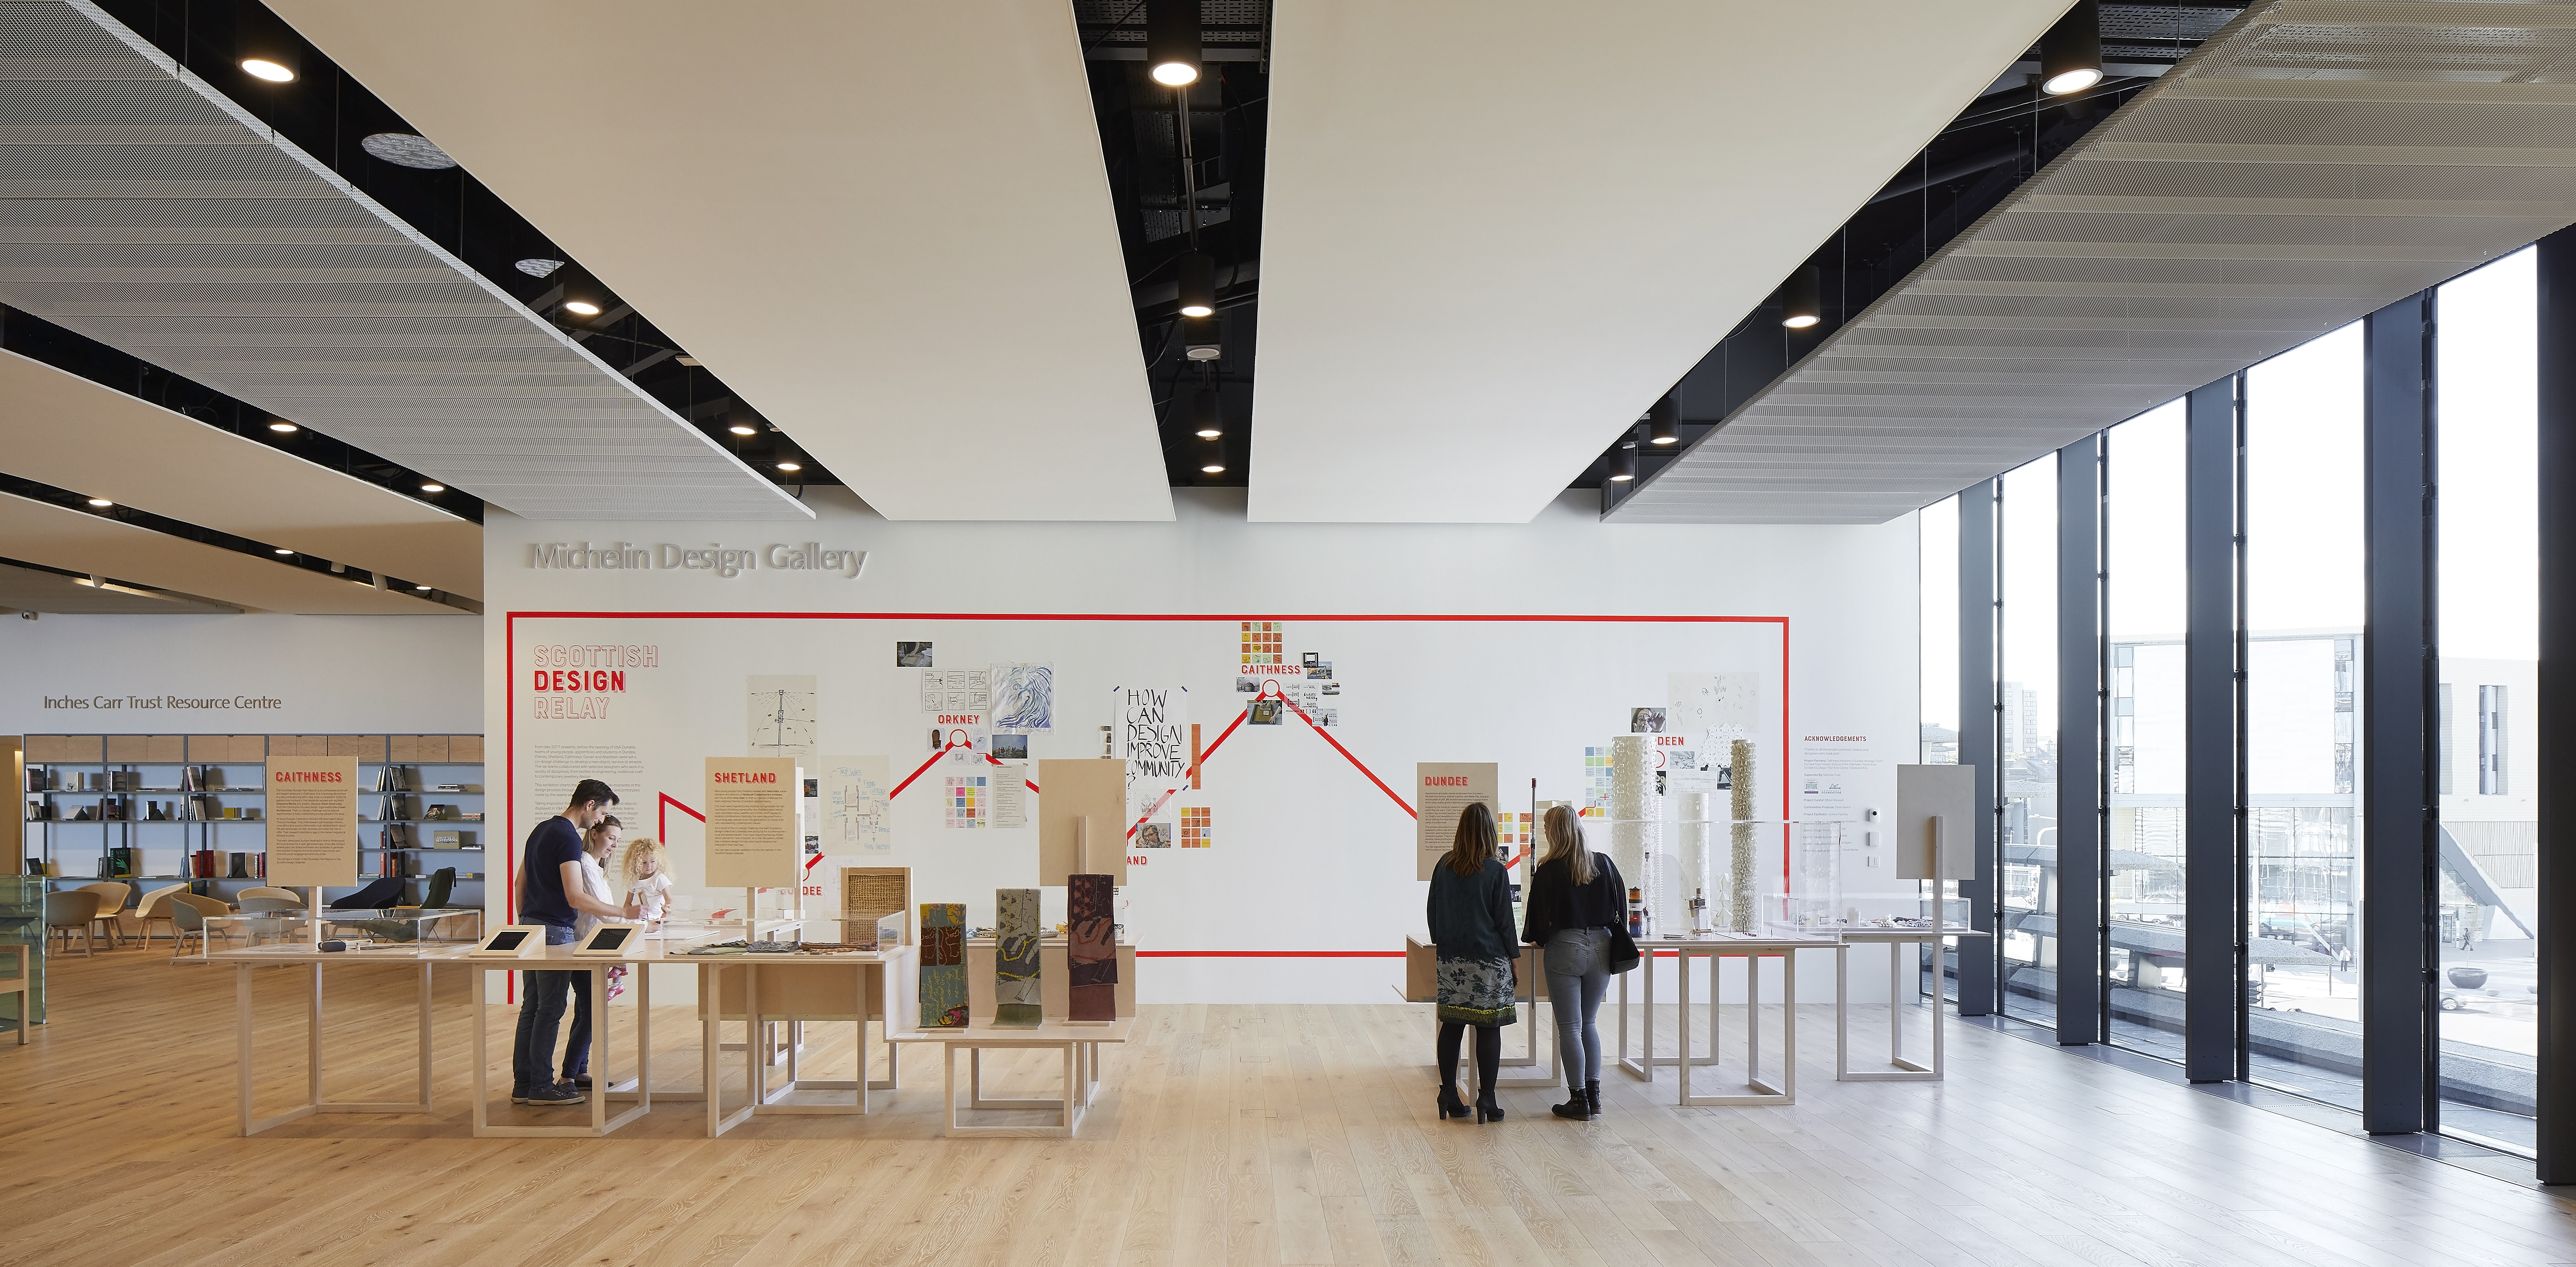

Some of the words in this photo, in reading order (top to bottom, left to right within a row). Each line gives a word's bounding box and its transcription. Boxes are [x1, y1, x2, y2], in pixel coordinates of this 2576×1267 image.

[532, 542, 652, 569] Michelin
[664, 543, 757, 578] Design
[770, 543, 868, 580] Gallery
[534, 645, 658, 668] SCOTTISH
[1241, 665, 1301, 675] CAITHNESS
[534, 671, 627, 693] DESIGN
[44, 696, 89, 709] Inches
[94, 696, 123, 709] Carr
[128, 696, 162, 709] Trust
[167, 696, 230, 709] Resource
[235, 696, 281, 709] Centre
[1127, 689, 1168, 707] HOW
[534, 697, 609, 719] RELAY
[938, 714, 980, 725] ORKNEY
[1126, 707, 1164, 724] CAN
[1127, 724, 1181, 744] DESIGN
[1658, 737, 1684, 746] DEEN
[1127, 742, 1181, 760] IMPROVE
[276, 772, 342, 783] CAITHNESS
[715, 772, 776, 784] SHETLAND
[1128, 775, 1136, 789] ?
[1425, 776, 1468, 787] DUNDEE
[1127, 856, 1147, 865] AND
